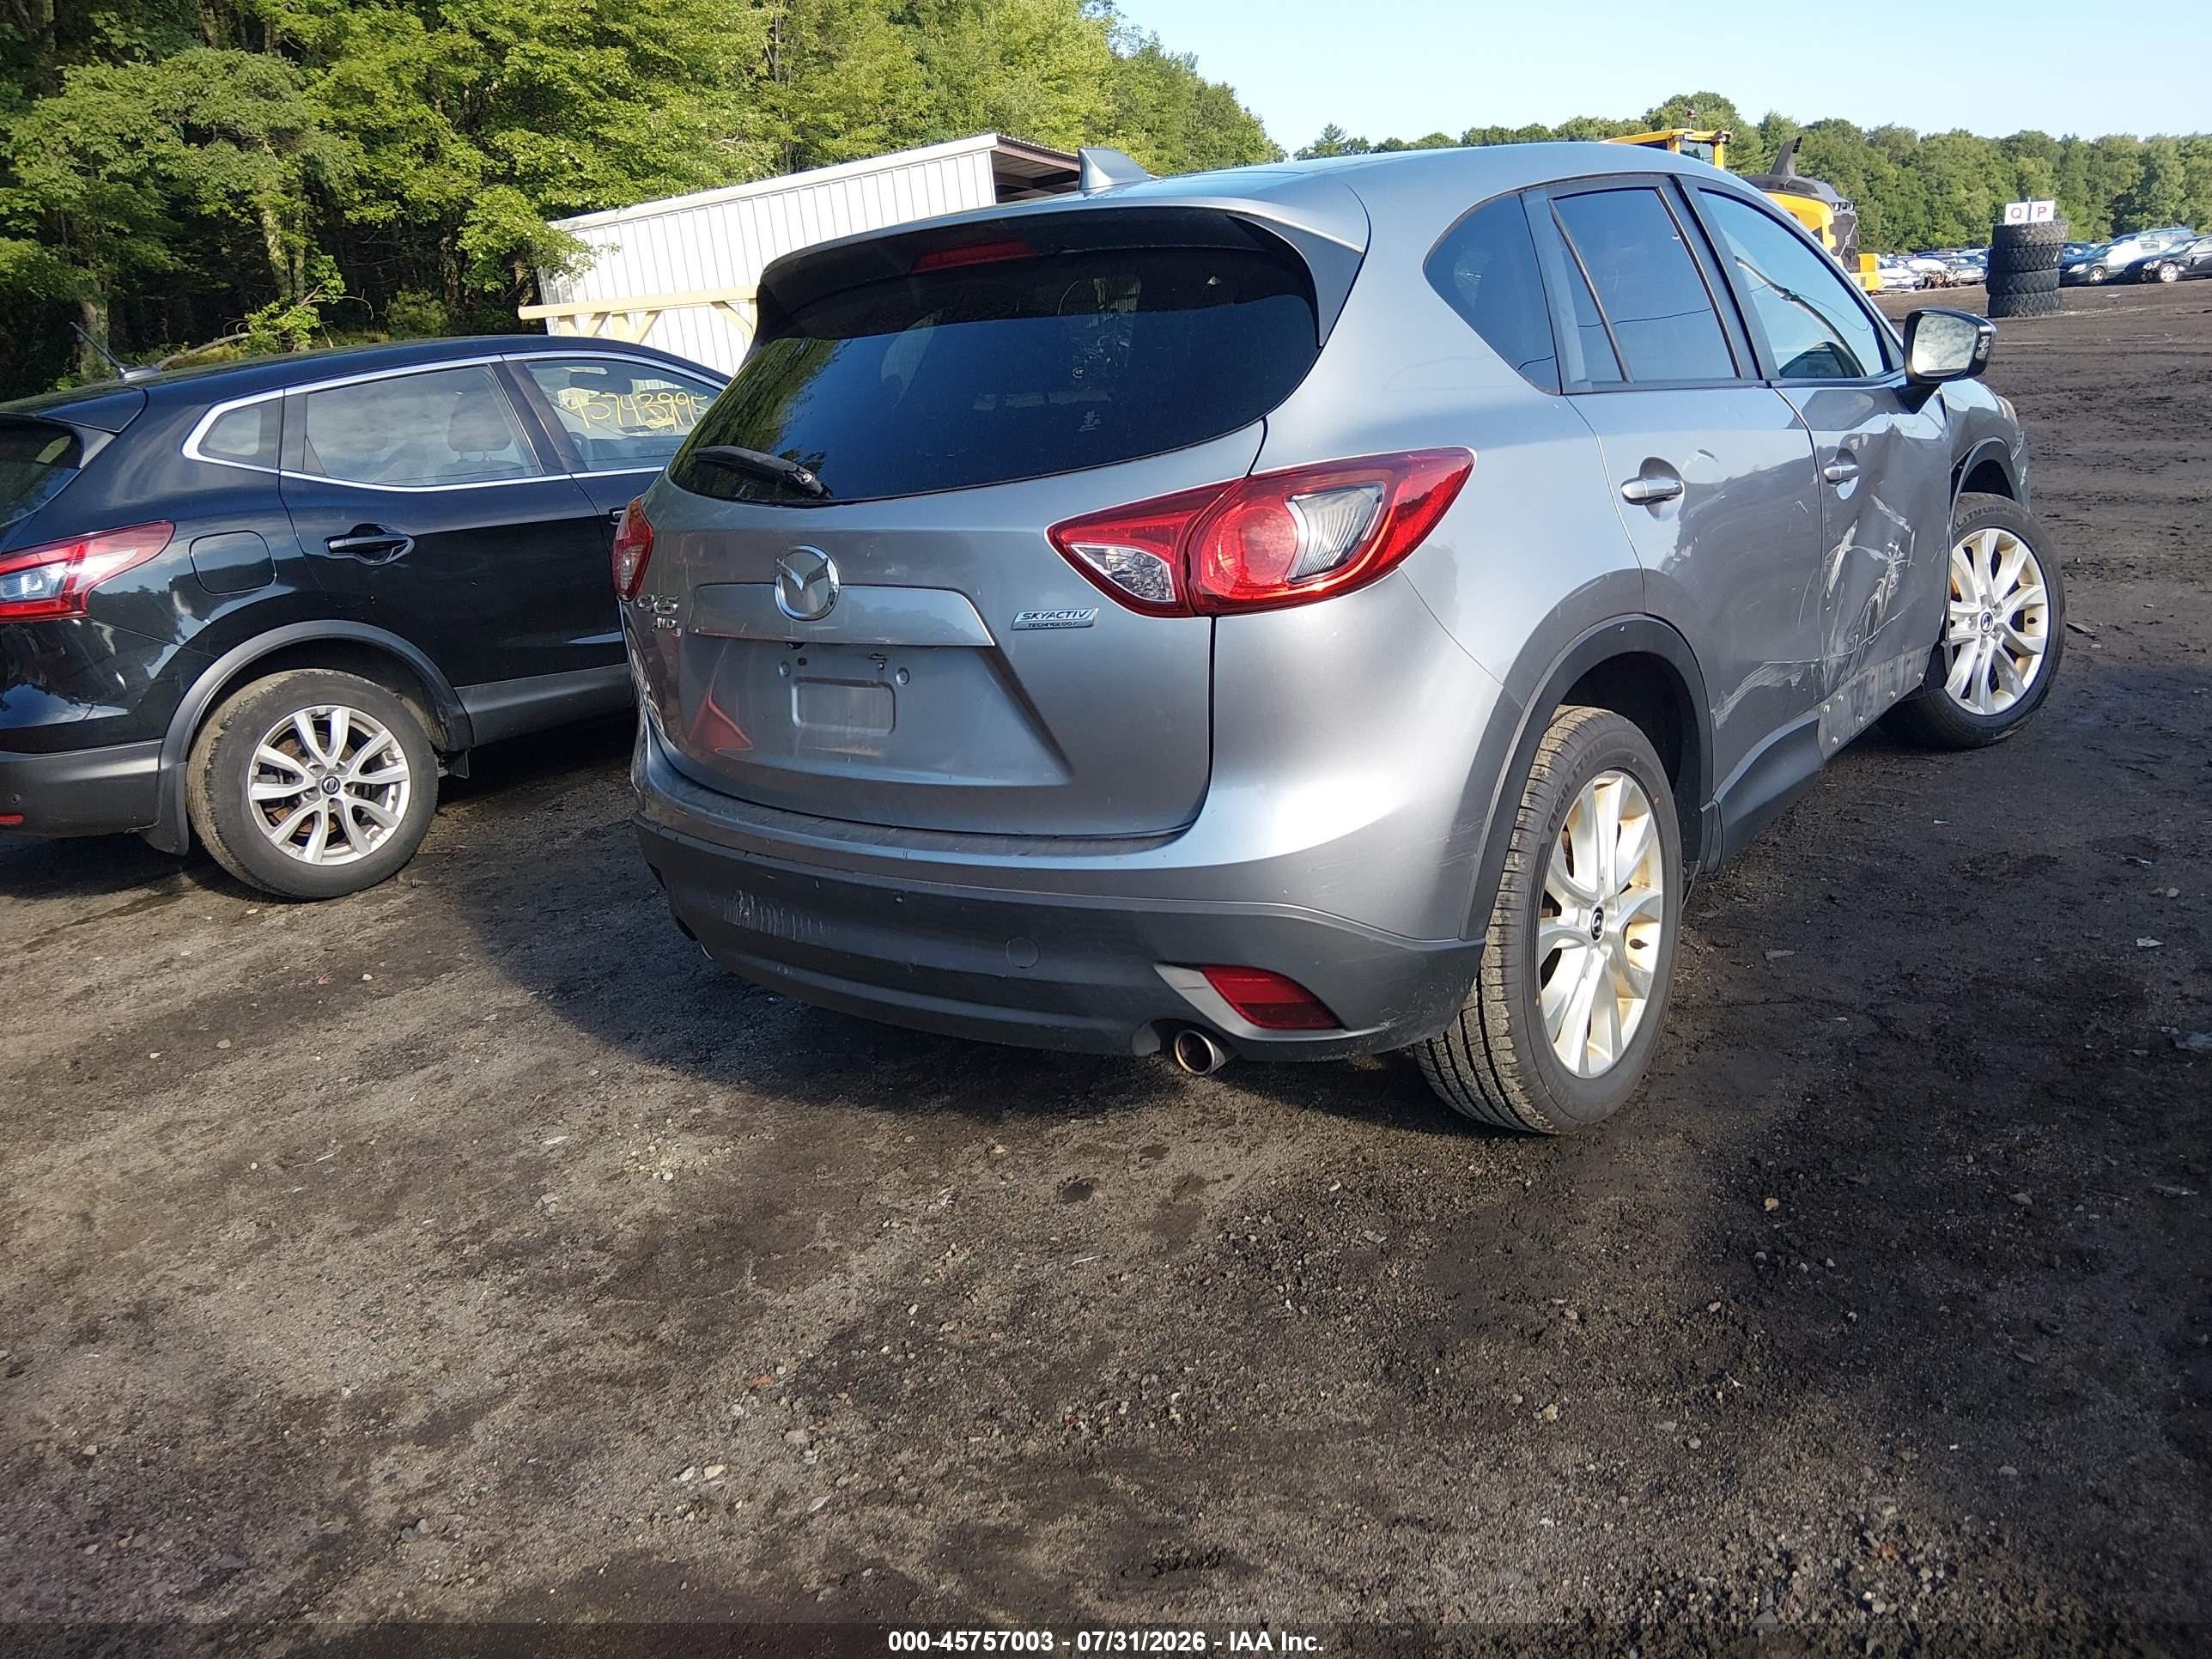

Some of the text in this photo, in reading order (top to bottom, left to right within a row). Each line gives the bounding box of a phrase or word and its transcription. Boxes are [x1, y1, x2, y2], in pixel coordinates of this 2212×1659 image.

[2010, 207, 2022, 220] Q
[2037, 206, 2047, 218] P
[1020, 610, 1090, 620] SKYACTIV
